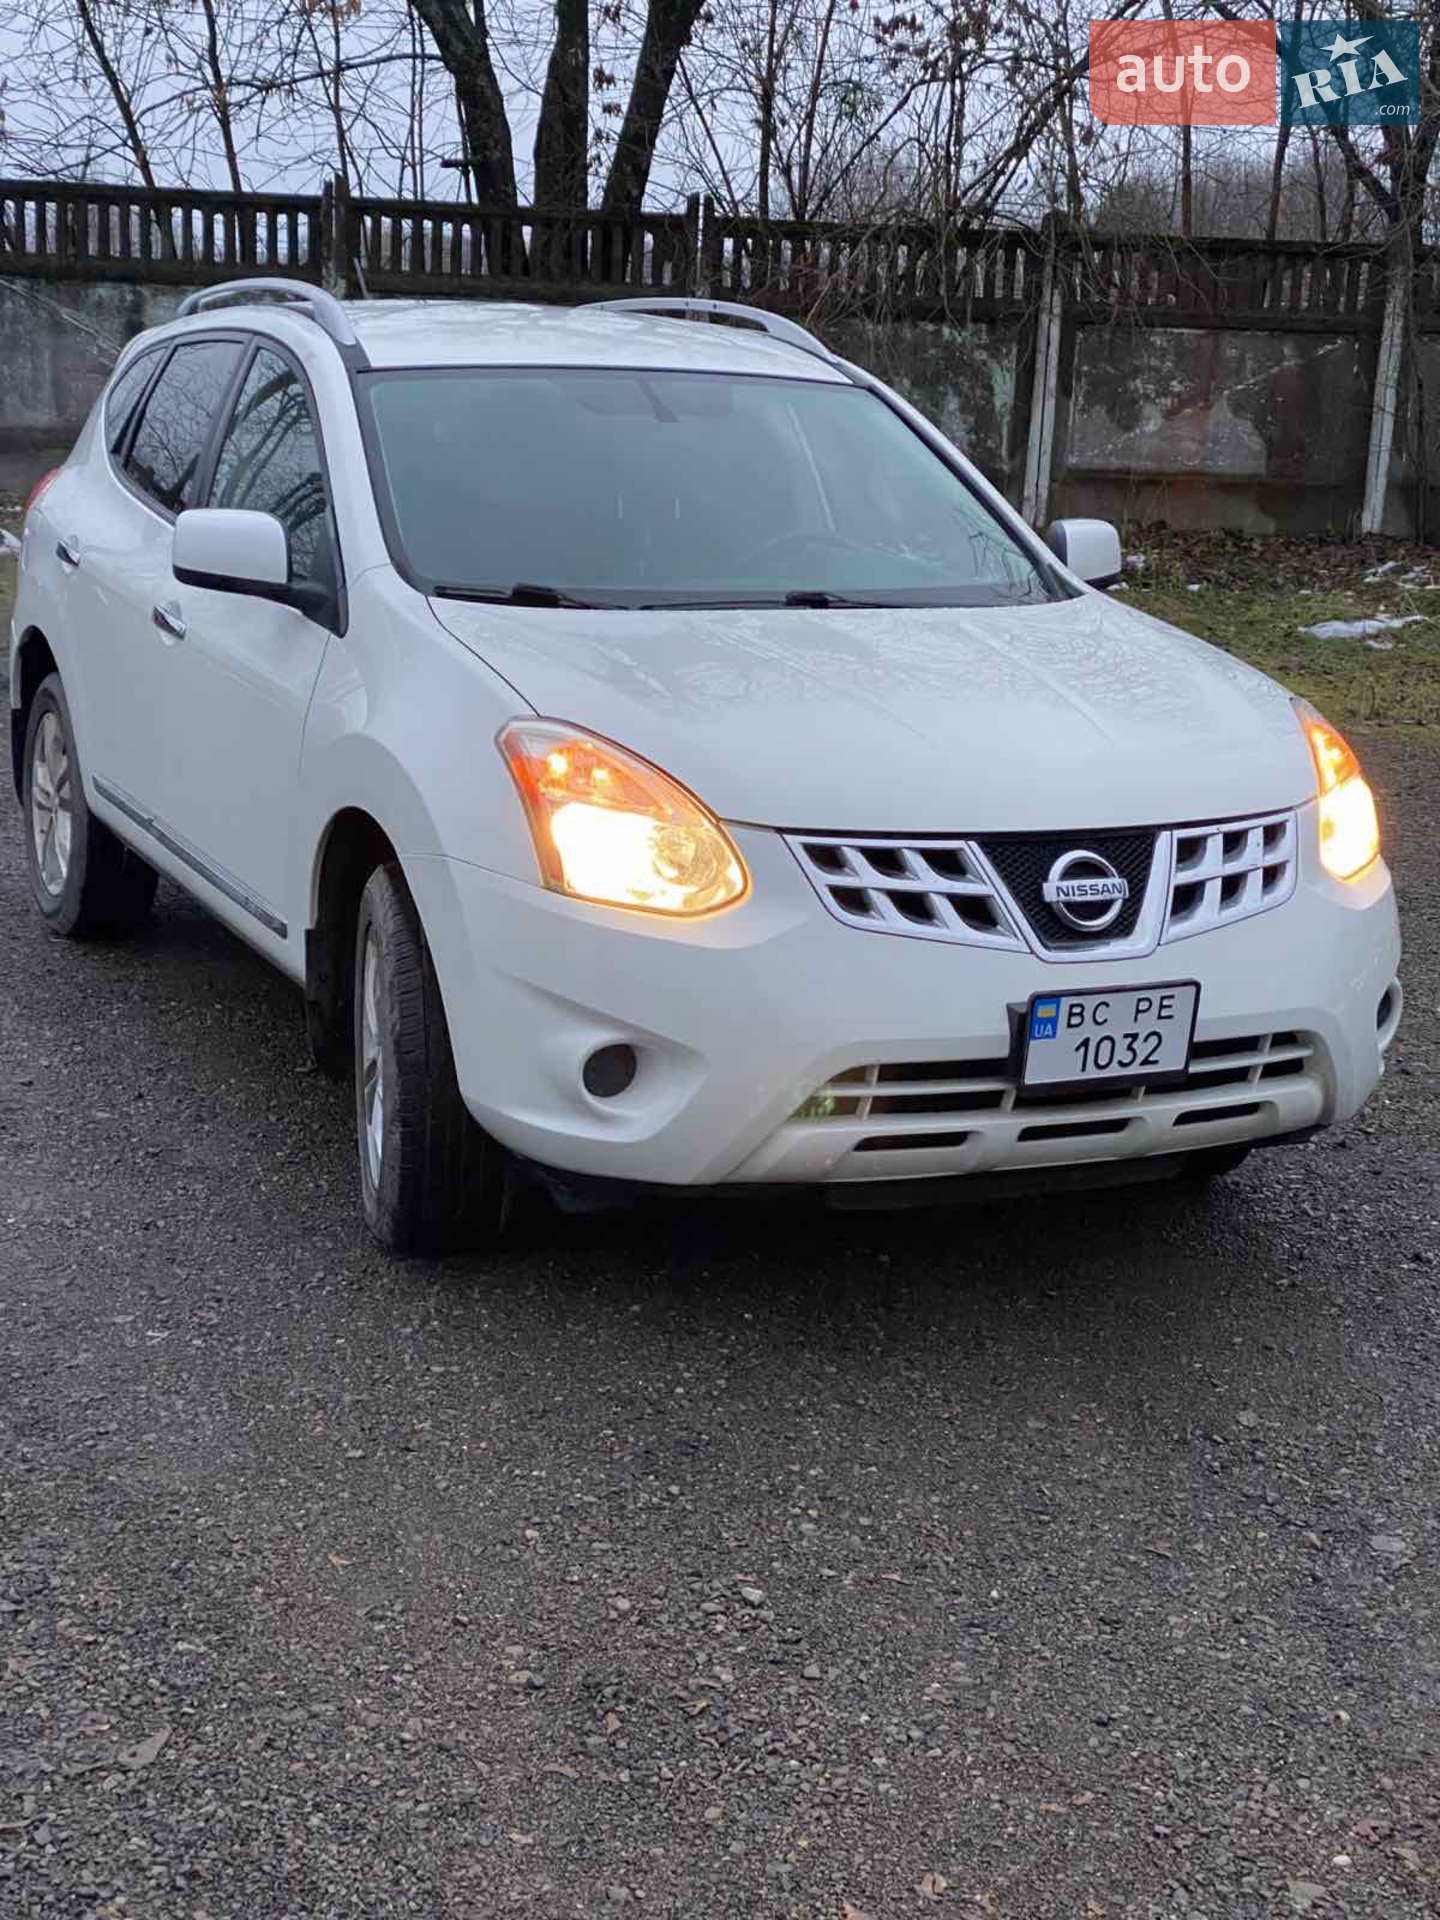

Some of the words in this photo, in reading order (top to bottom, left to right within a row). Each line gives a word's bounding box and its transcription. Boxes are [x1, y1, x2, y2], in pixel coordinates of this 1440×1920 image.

[1055, 881, 1123, 898] NISSAN
[1066, 1001, 1110, 1029] BC
[1134, 995, 1175, 1023] PE
[1033, 1026, 1053, 1038] UA
[1074, 1030, 1162, 1072] 1032
